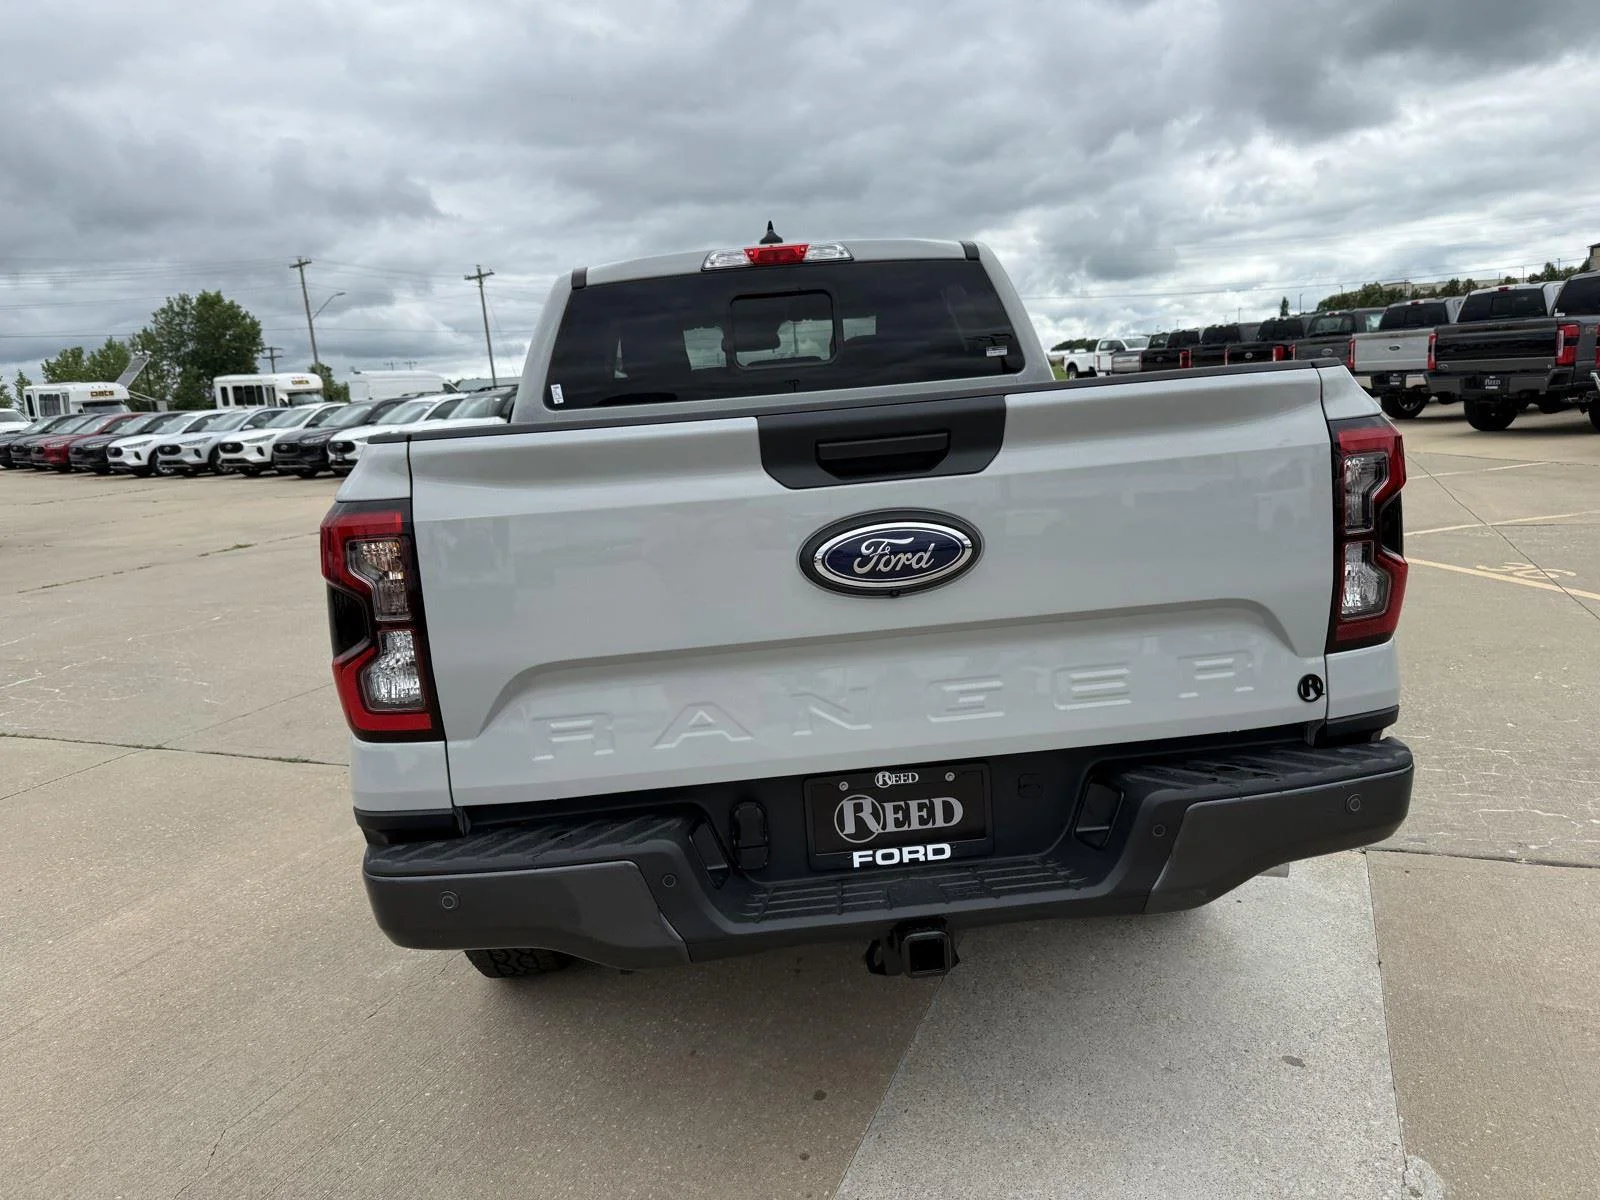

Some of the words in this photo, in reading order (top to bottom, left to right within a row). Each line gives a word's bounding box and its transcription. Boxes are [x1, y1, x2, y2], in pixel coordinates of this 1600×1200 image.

[853, 536, 937, 574] Ford
[532, 649, 1255, 761] RANGER
[875, 771, 919, 788] REED
[840, 796, 964, 837] REED
[852, 843, 951, 868] FORD
